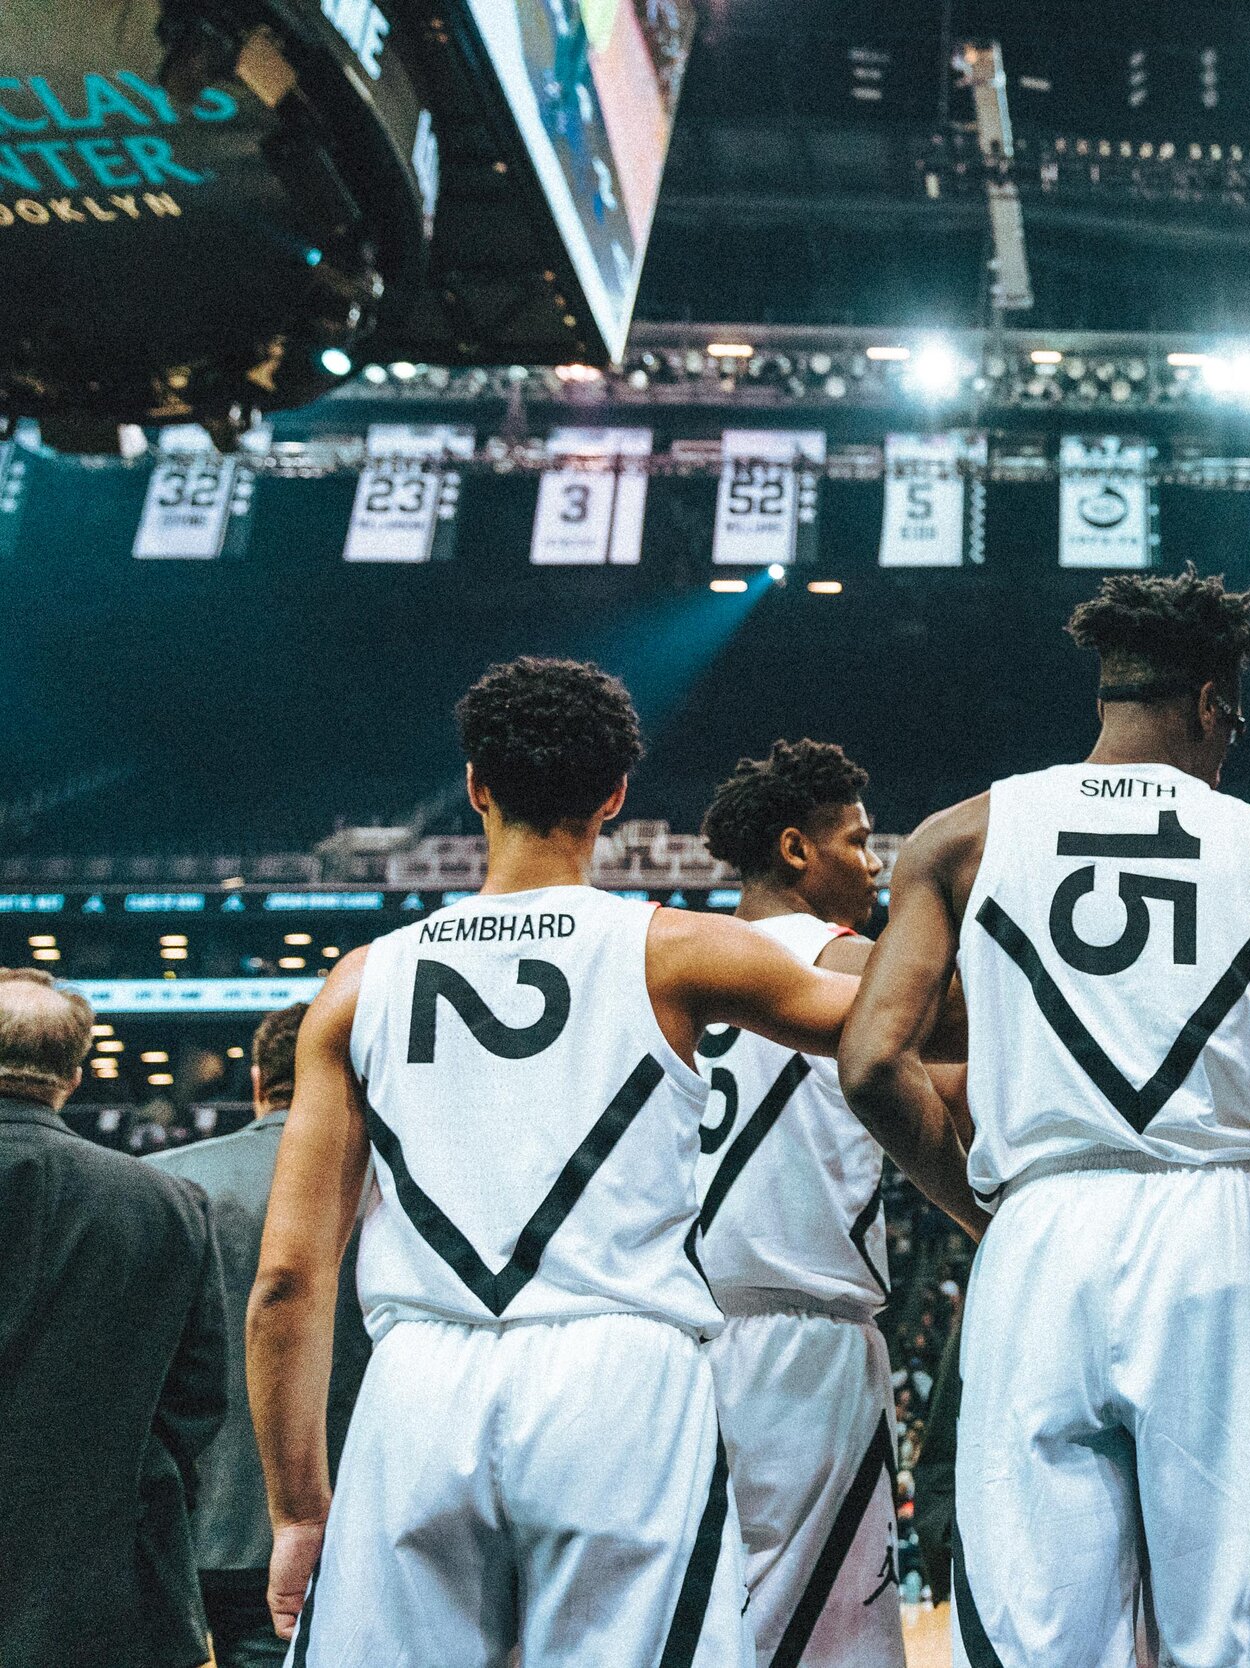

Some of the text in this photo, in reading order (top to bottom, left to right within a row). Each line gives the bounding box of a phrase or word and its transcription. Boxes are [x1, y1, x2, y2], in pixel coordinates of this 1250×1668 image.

[158, 472, 219, 507] 32
[366, 477, 426, 512] 23
[560, 484, 590, 523] 3
[729, 480, 784, 514] 52
[907, 482, 932, 520] 5
[1080, 778, 1176, 798] SMITH
[1049, 810, 1201, 976] 15
[419, 913, 576, 944] NEMBHARD
[407, 958, 571, 1064] 2
